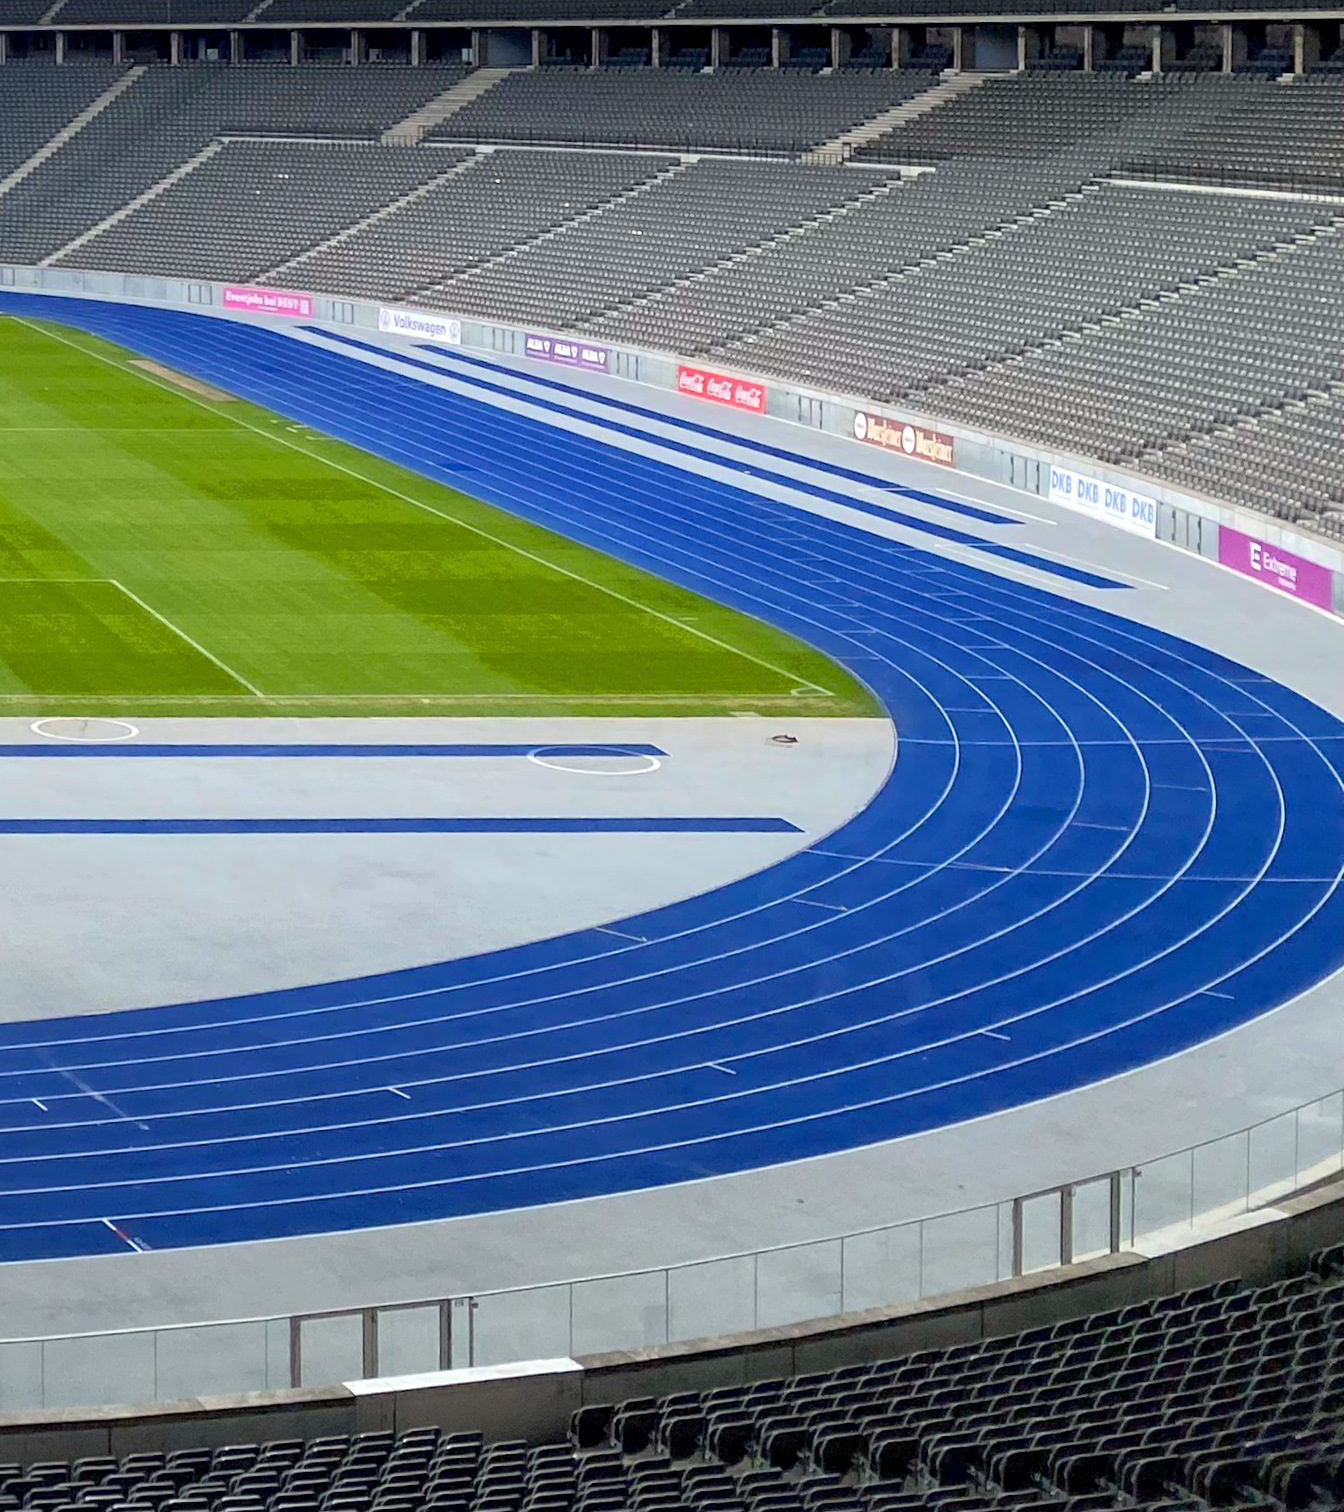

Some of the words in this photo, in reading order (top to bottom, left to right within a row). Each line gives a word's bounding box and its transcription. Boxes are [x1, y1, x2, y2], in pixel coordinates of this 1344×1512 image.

[393, 313, 447, 338] Volkswagen
[1051, 470, 1072, 494] DKB
[1077, 478, 1100, 504] DKB
[1104, 487, 1127, 513] DKB
[1132, 497, 1155, 524] DKB
